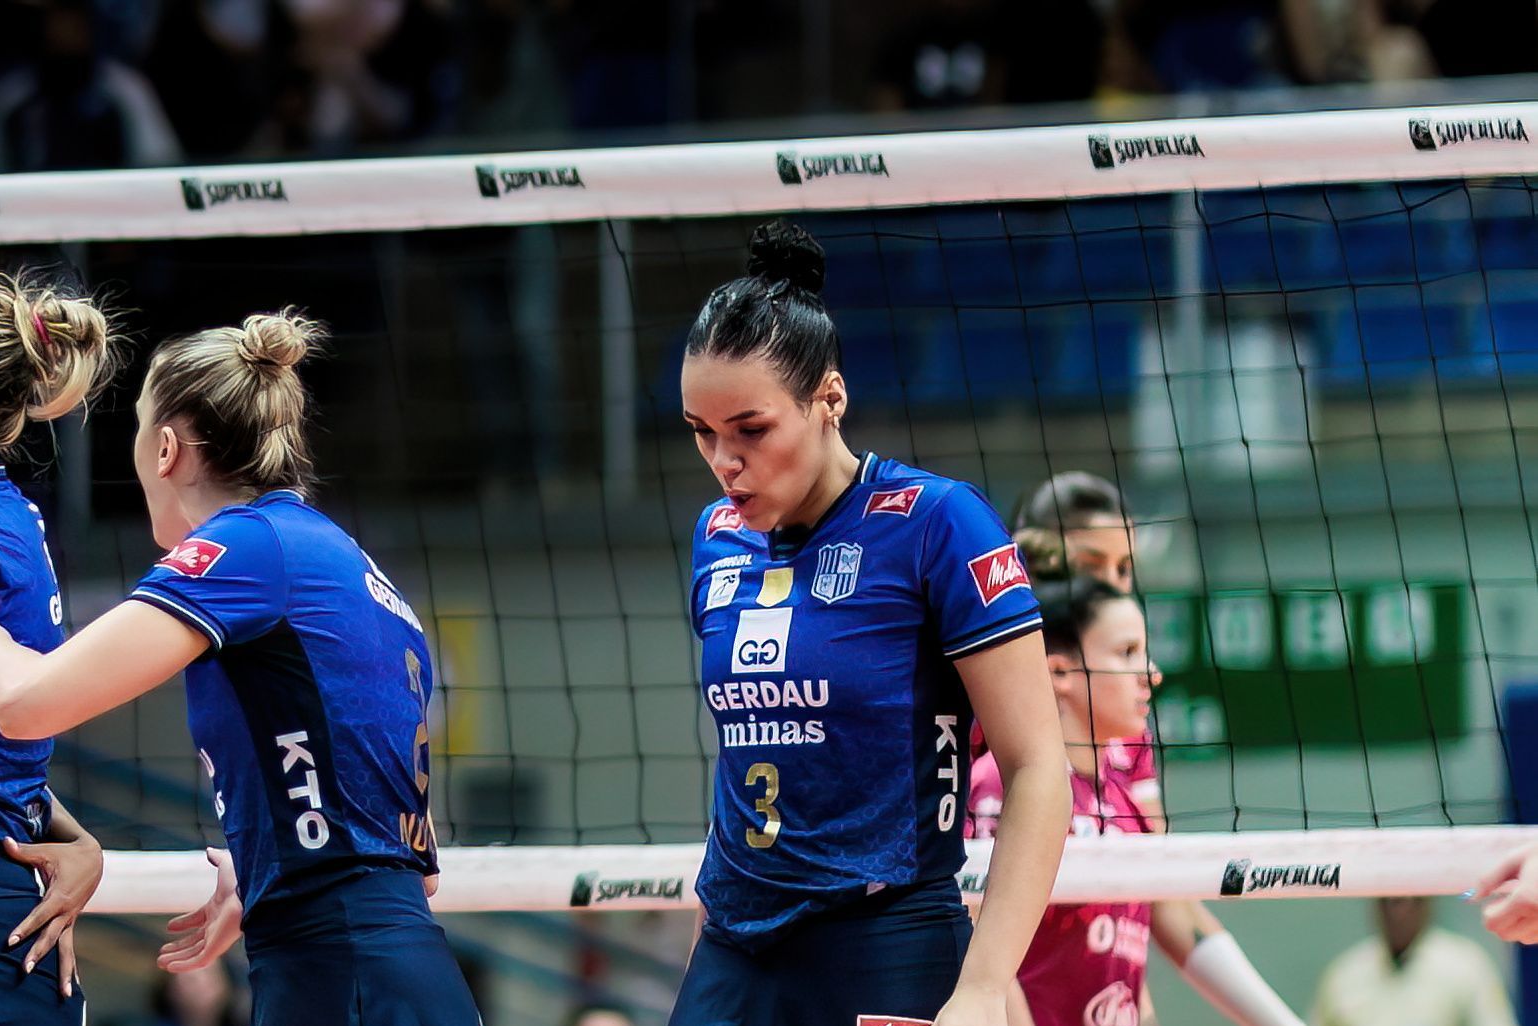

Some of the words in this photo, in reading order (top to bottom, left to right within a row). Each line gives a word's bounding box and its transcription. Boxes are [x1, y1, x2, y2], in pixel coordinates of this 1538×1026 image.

[1435, 118, 1529, 145] SUPERLIGA
[1114, 134, 1206, 162] SUPERLIGA
[501, 165, 585, 190] SUPERLIGA
[802, 153, 890, 179] SUPERLIGA
[206, 178, 288, 203] SUPERLIGA
[707, 679, 829, 712] GERDAU
[722, 714, 826, 748] minas
[934, 715, 959, 832] KTO
[275, 730, 330, 850] KTO
[745, 762, 782, 849] 3
[595, 877, 684, 903] SUPERLIGA
[1247, 862, 1342, 892] SUPERLIGA
